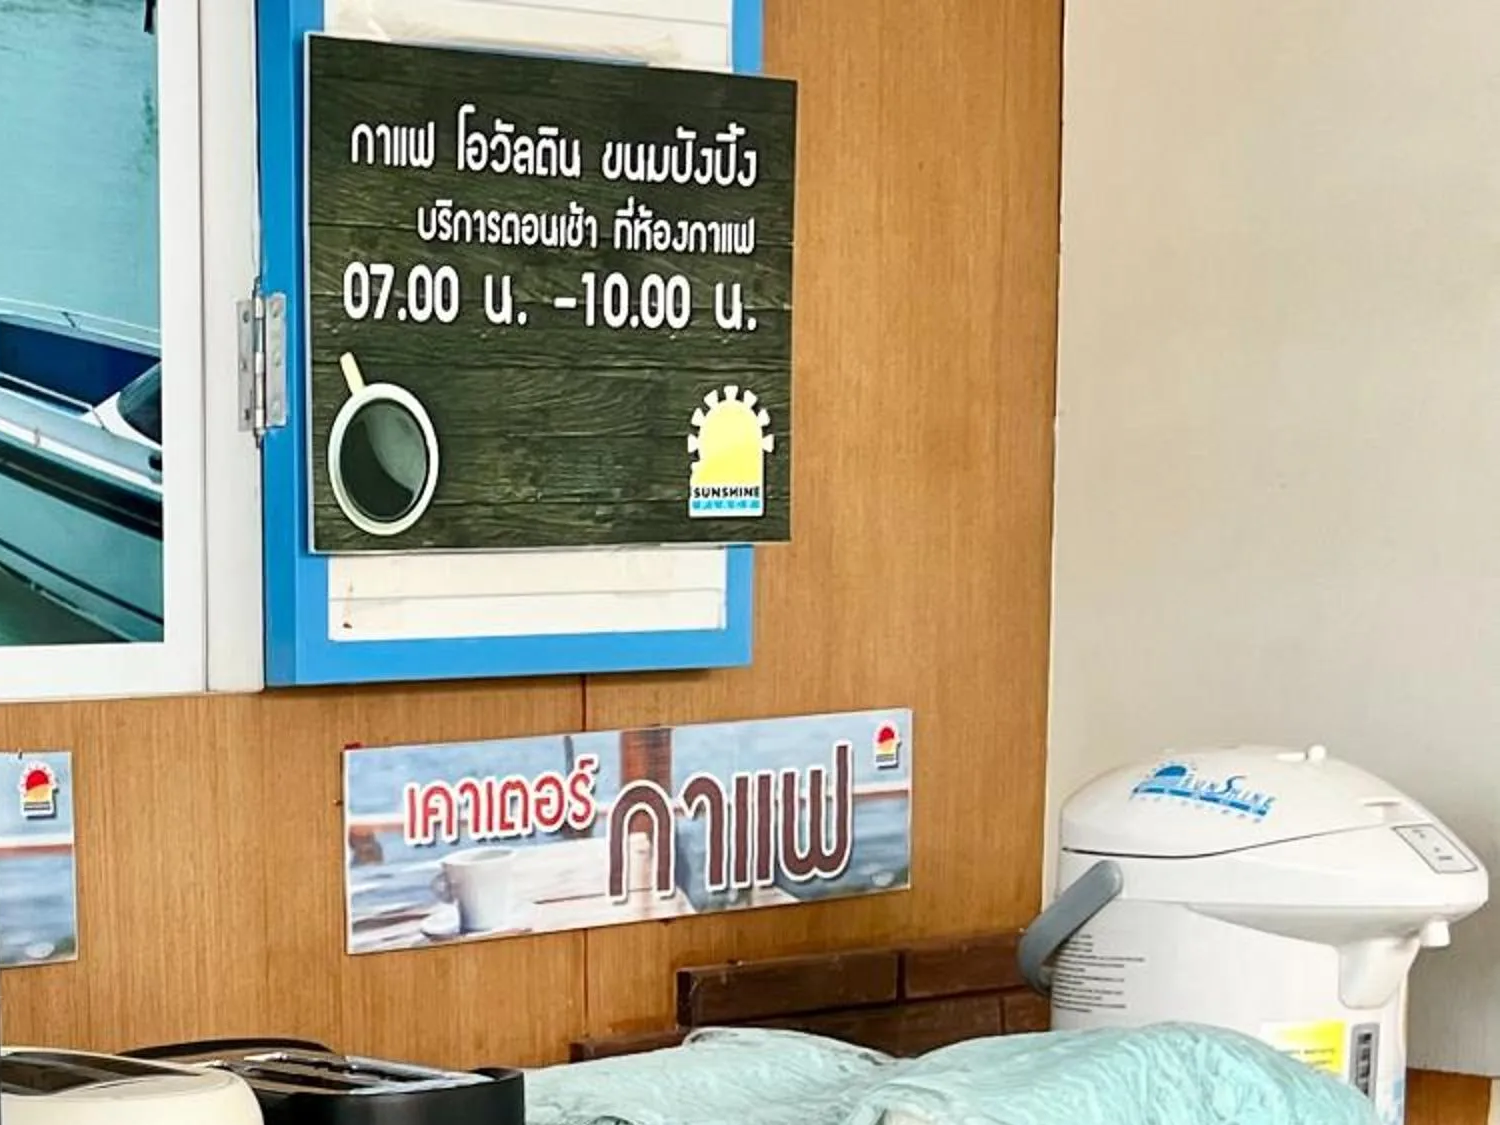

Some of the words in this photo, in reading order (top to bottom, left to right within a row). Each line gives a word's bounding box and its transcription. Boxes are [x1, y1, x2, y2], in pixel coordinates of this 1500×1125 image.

[350, 120, 436, 168] กาแฟ
[456, 104, 581, 178] โอวัลติน
[602, 122, 757, 187] ขนมปังปิ้ง
[417, 199, 597, 248] บริการตอนเช้า
[613, 196, 756, 254] ที่ห้องกาแฟ
[342, 262, 459, 323] 07.00
[484, 273, 528, 325] น.
[714, 281, 758, 331] น.
[693, 485, 760, 498] SUNSHINE
[407, 758, 595, 840] เคาเตอร์
[606, 742, 852, 898] กาแฟ
